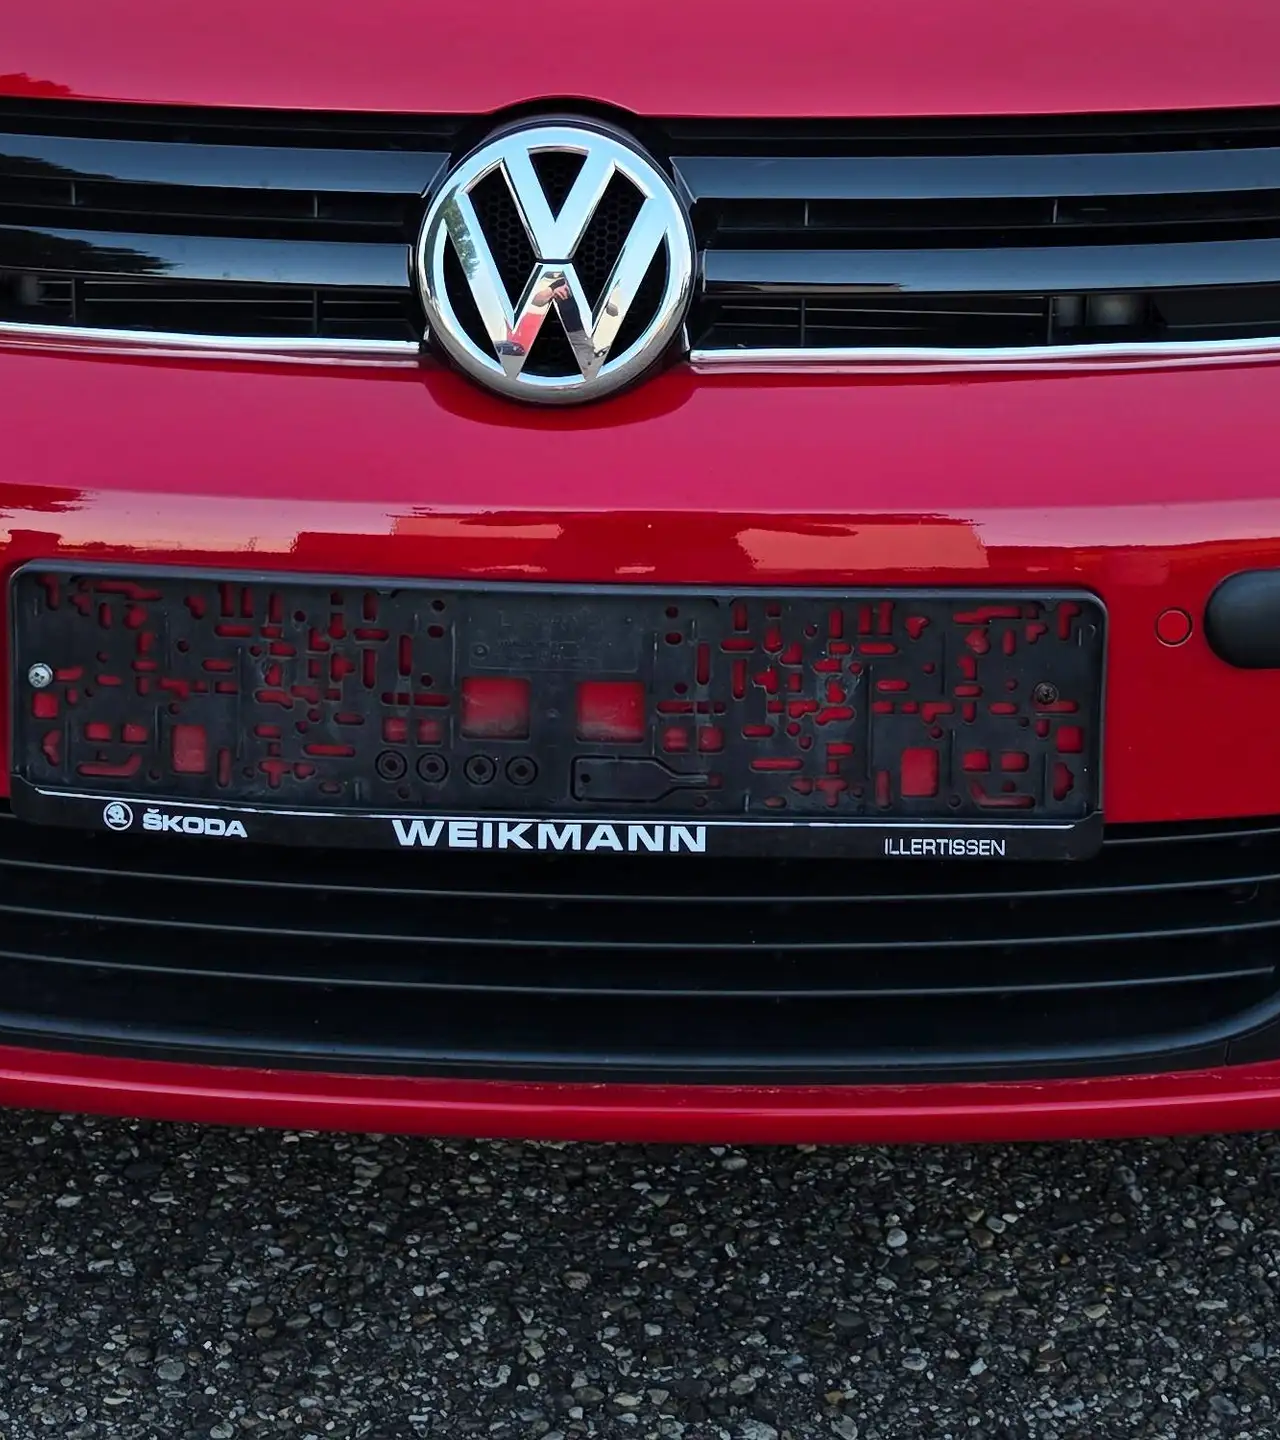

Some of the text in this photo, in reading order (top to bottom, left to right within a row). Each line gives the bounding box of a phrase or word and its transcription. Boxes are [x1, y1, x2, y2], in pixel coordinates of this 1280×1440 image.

[428, 134, 684, 390] VW
[142, 808, 248, 838] ŠKODA
[392, 820, 706, 852] WEIKMANN
[884, 838, 1006, 856] ILLERTISSEN
